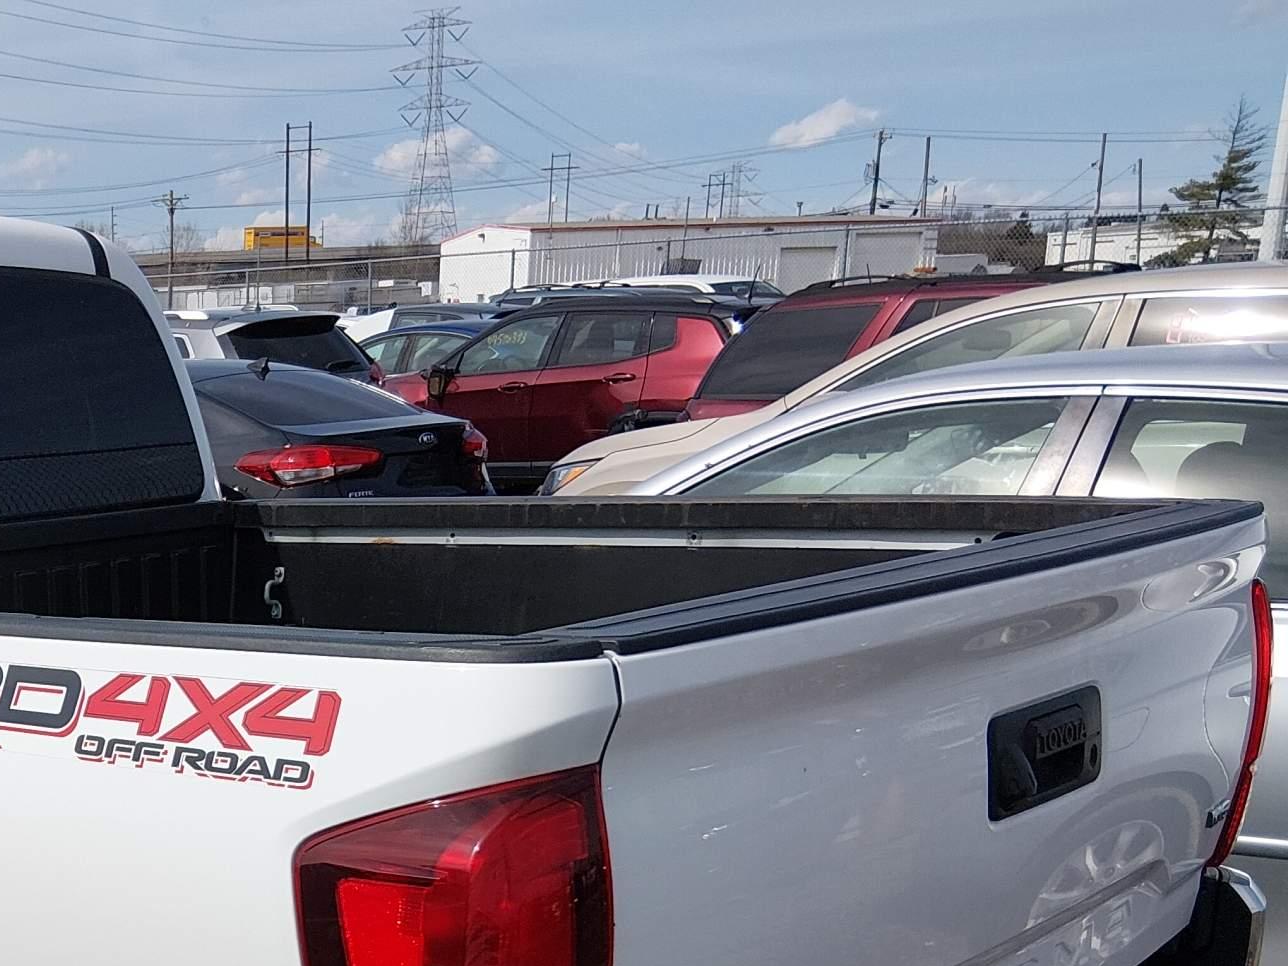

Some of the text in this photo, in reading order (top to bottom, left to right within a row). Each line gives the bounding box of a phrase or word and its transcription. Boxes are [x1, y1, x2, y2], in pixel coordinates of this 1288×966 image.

[1037, 718, 1087, 755] TOYOTA
[74, 734, 315, 790] OFF ROAD
